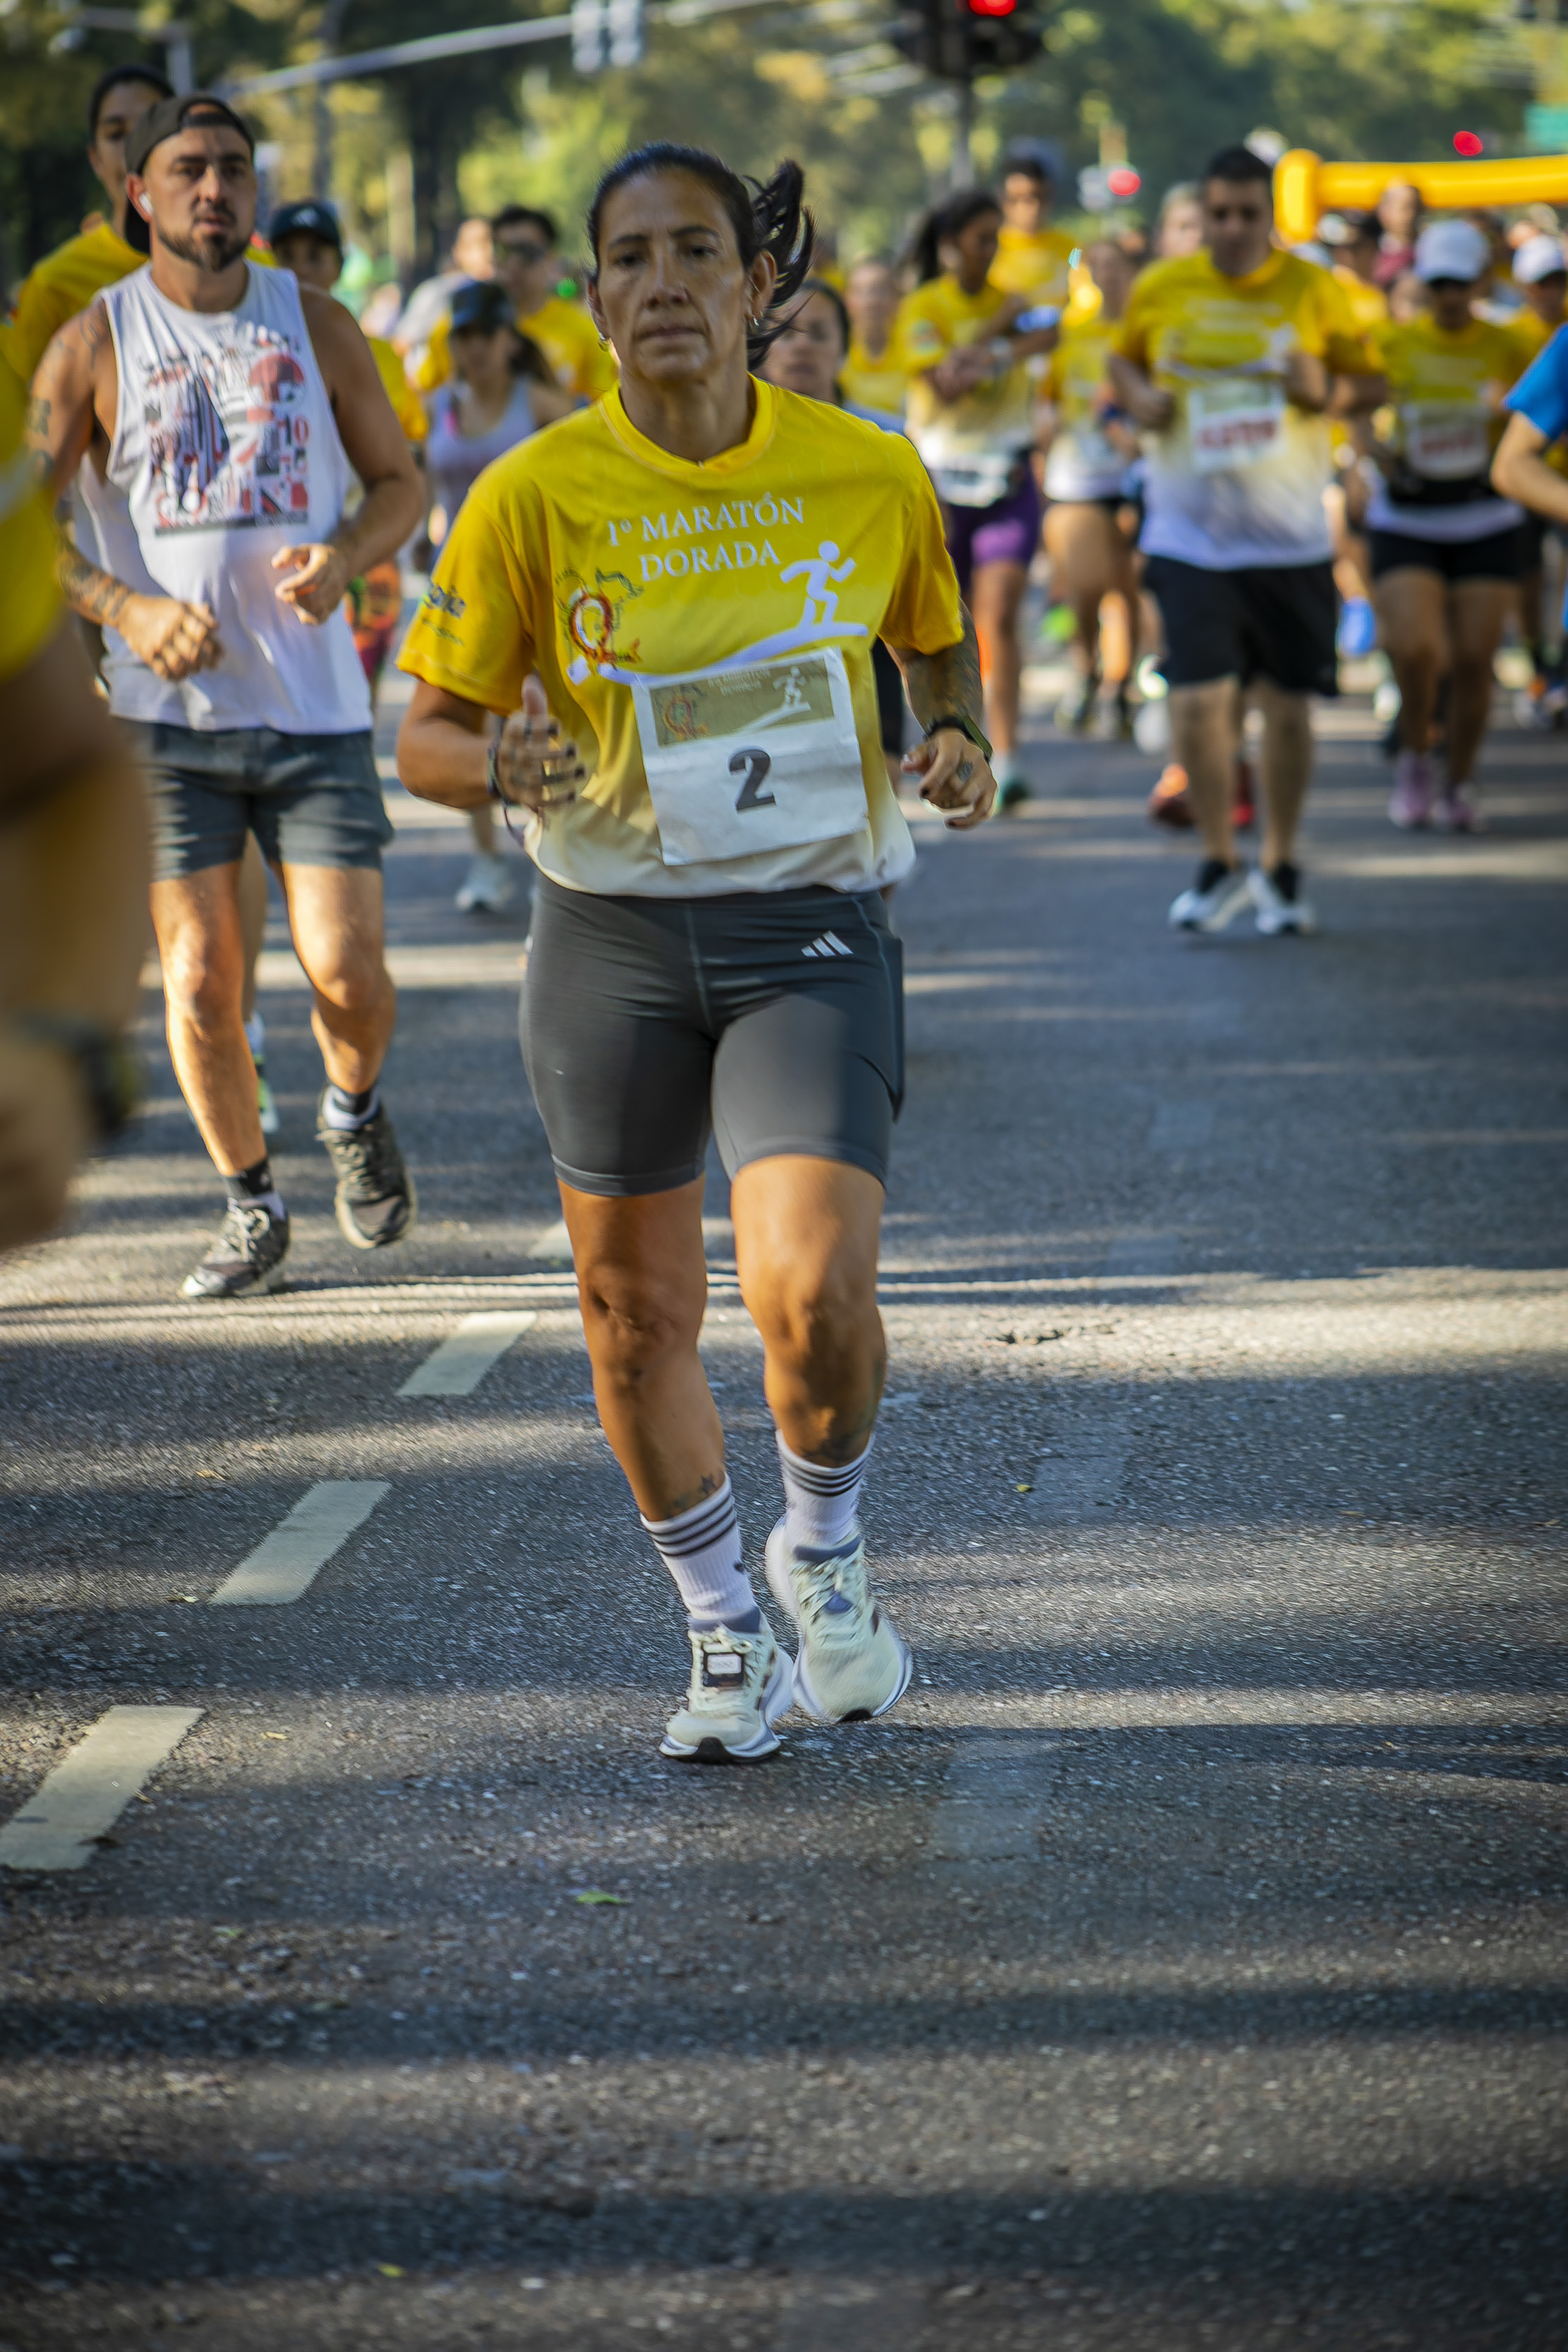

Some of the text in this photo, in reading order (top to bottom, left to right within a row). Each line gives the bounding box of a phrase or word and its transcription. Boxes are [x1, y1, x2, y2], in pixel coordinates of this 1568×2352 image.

[641, 491, 803, 542] MARATÓN
[639, 539, 781, 581] DORADA
[729, 749, 777, 812] 2
